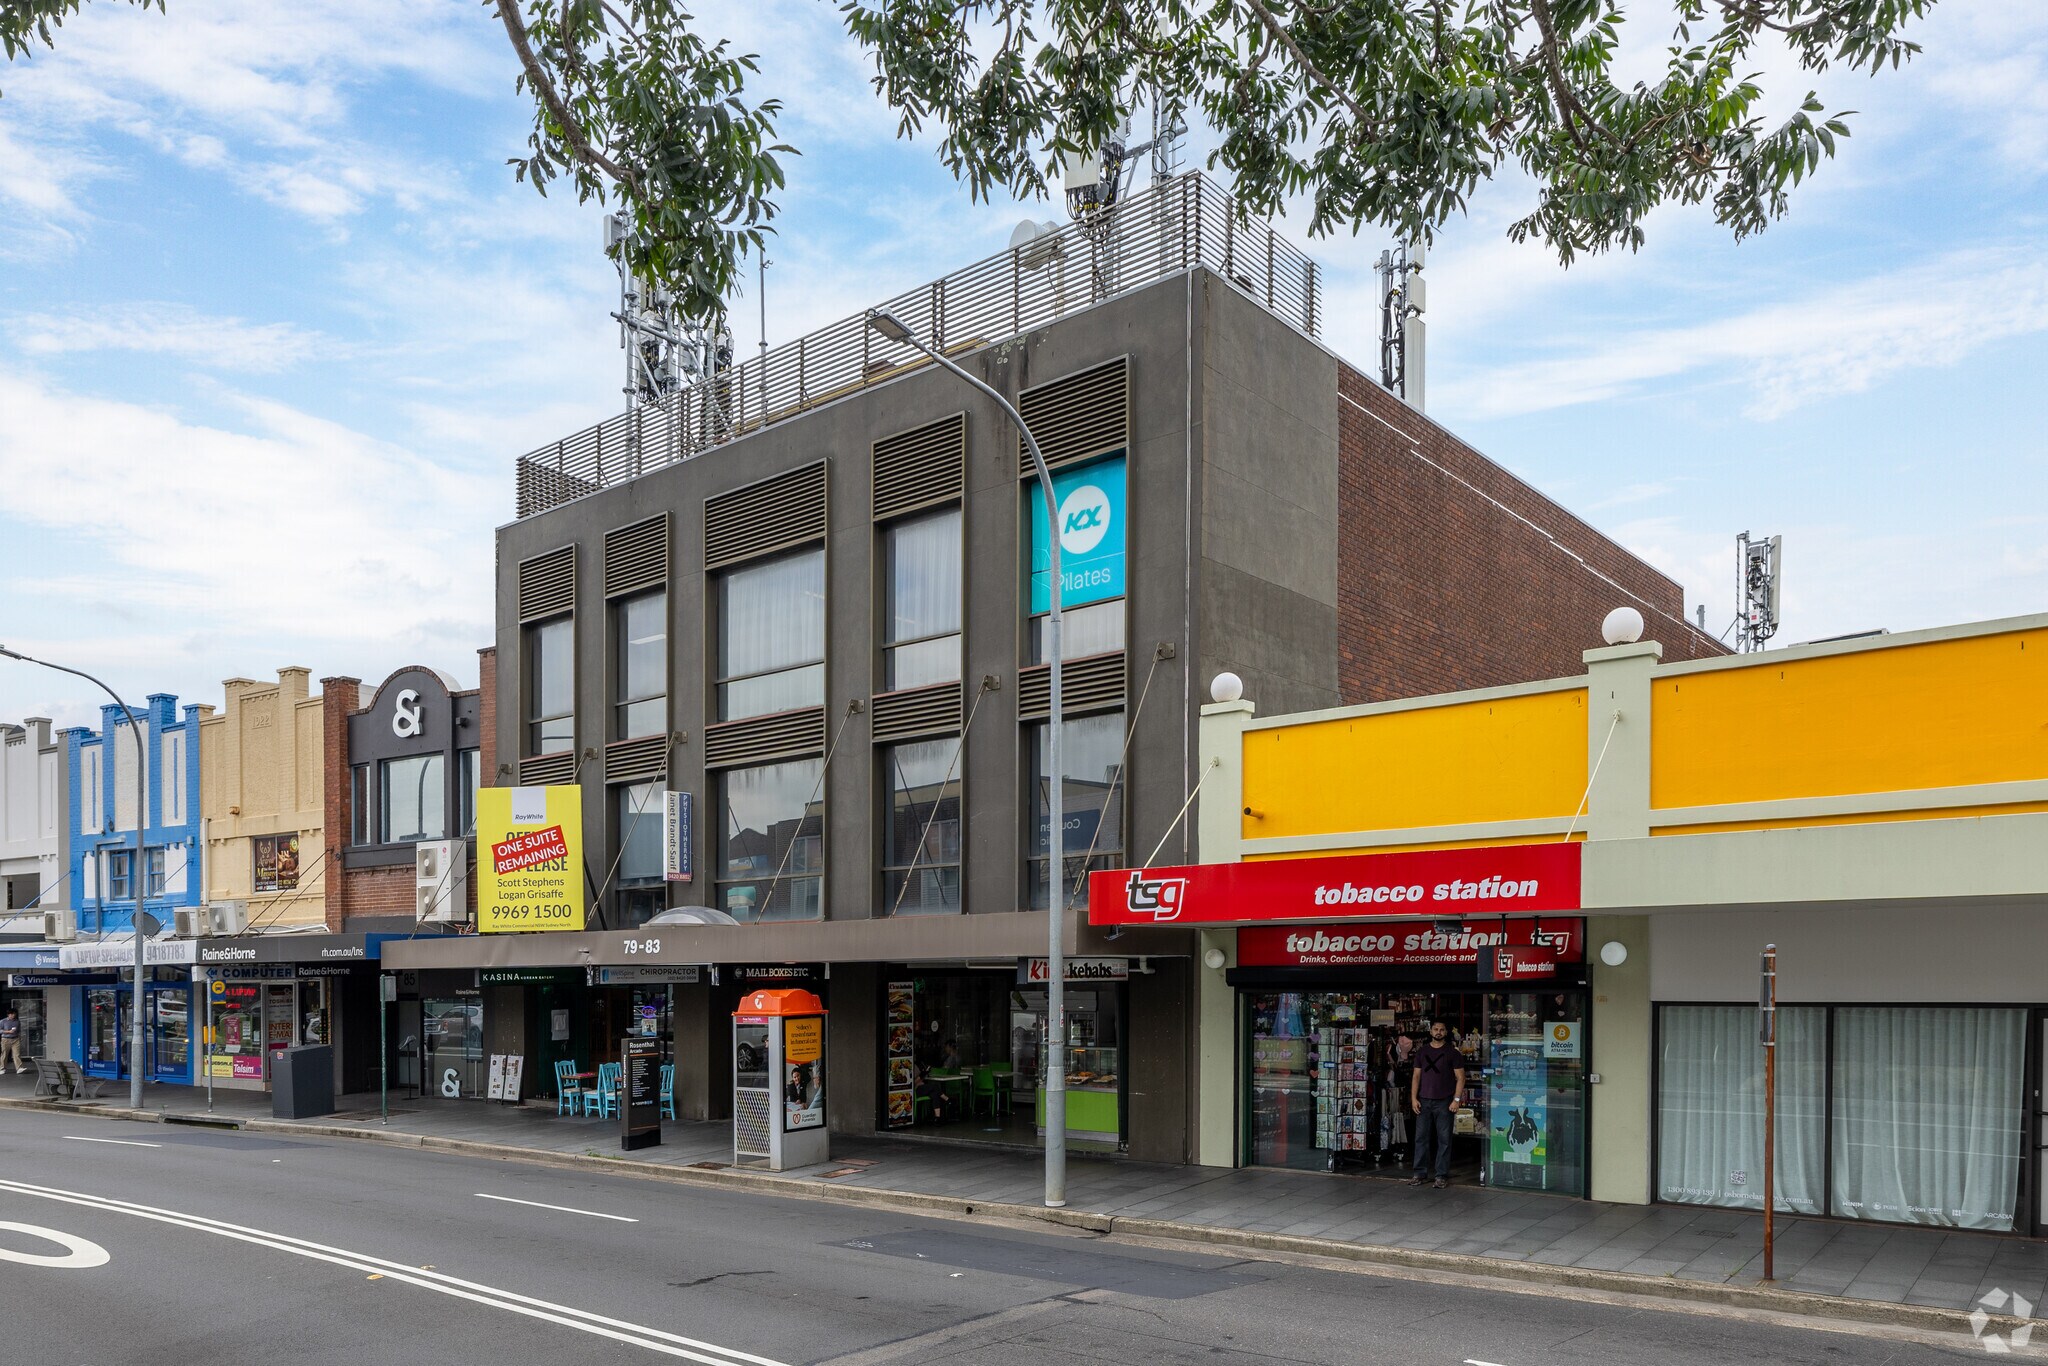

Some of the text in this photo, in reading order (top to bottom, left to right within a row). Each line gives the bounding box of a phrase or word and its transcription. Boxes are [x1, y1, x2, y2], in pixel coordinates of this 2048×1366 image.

[1064, 505, 1102, 534] KX
[393, 689, 420, 738] &
[669, 793, 677, 816] Janet
[498, 840, 524, 856] ONE
[525, 829, 559, 848] SUITE
[498, 844, 566, 872] REMAINING
[497, 878, 565, 889] Scott Stephens
[1314, 875, 1539, 905] tobacco station
[499, 889, 564, 901] Logan Grisaffe
[1126, 871, 1186, 921] tsg
[492, 904, 572, 919] 9969 1500
[624, 939, 661, 954] 79-83
[1286, 927, 1508, 953] tobacco station
[101, 948, 135, 963] SPECIALIS
[202, 947, 256, 961] Raine&Horne
[1300, 955, 1328, 964] Drinks,
[1330, 954, 1394, 963] Confectioneries
[1403, 954, 1457, 962] Accessories
[1459, 953, 1477, 962] and
[222, 968, 292, 978] COMPUTER
[299, 967, 350, 976] Raine&Horne
[640, 968, 697, 976] CHIROPRACTOR
[746, 968, 768, 977] MAIL
[768, 968, 793, 977] BOXES
[1069, 962, 1112, 978] kebabs
[1517, 961, 1554, 972] tobacco station
[27, 976, 58, 984] Vinnies
[403, 973, 415, 986] 85
[483, 973, 520, 981] KASINA
[629, 1041, 655, 1049] Rosenthal
[1667, 1186, 1685, 1194] 1300
[1724, 1191, 1814, 1205] osbornelanove.com.au
[1983, 1212, 2013, 1220] ARCADIA
